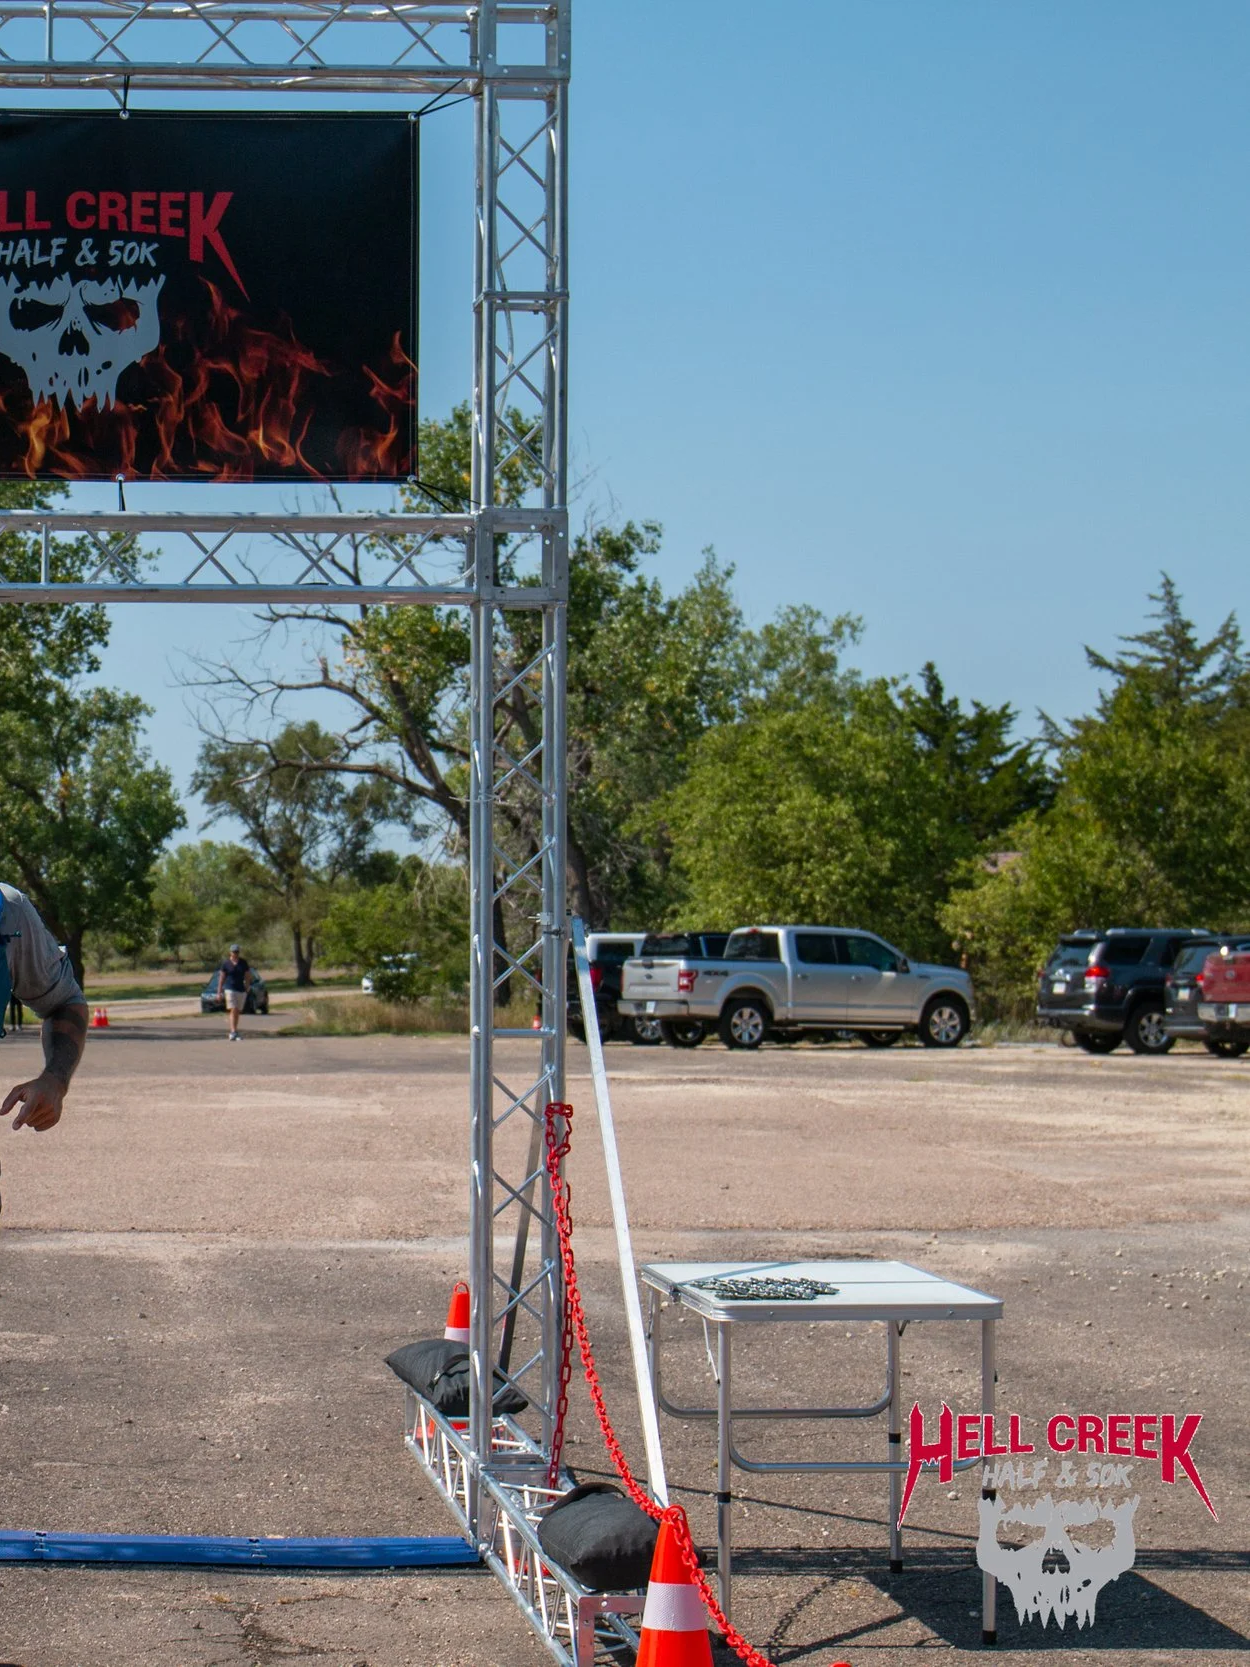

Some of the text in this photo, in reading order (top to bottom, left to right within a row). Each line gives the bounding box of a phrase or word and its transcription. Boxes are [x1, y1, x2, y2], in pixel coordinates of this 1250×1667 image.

[65, 190, 250, 302] CREEK
[75, 238, 99, 267] &
[109, 240, 160, 268] 50K
